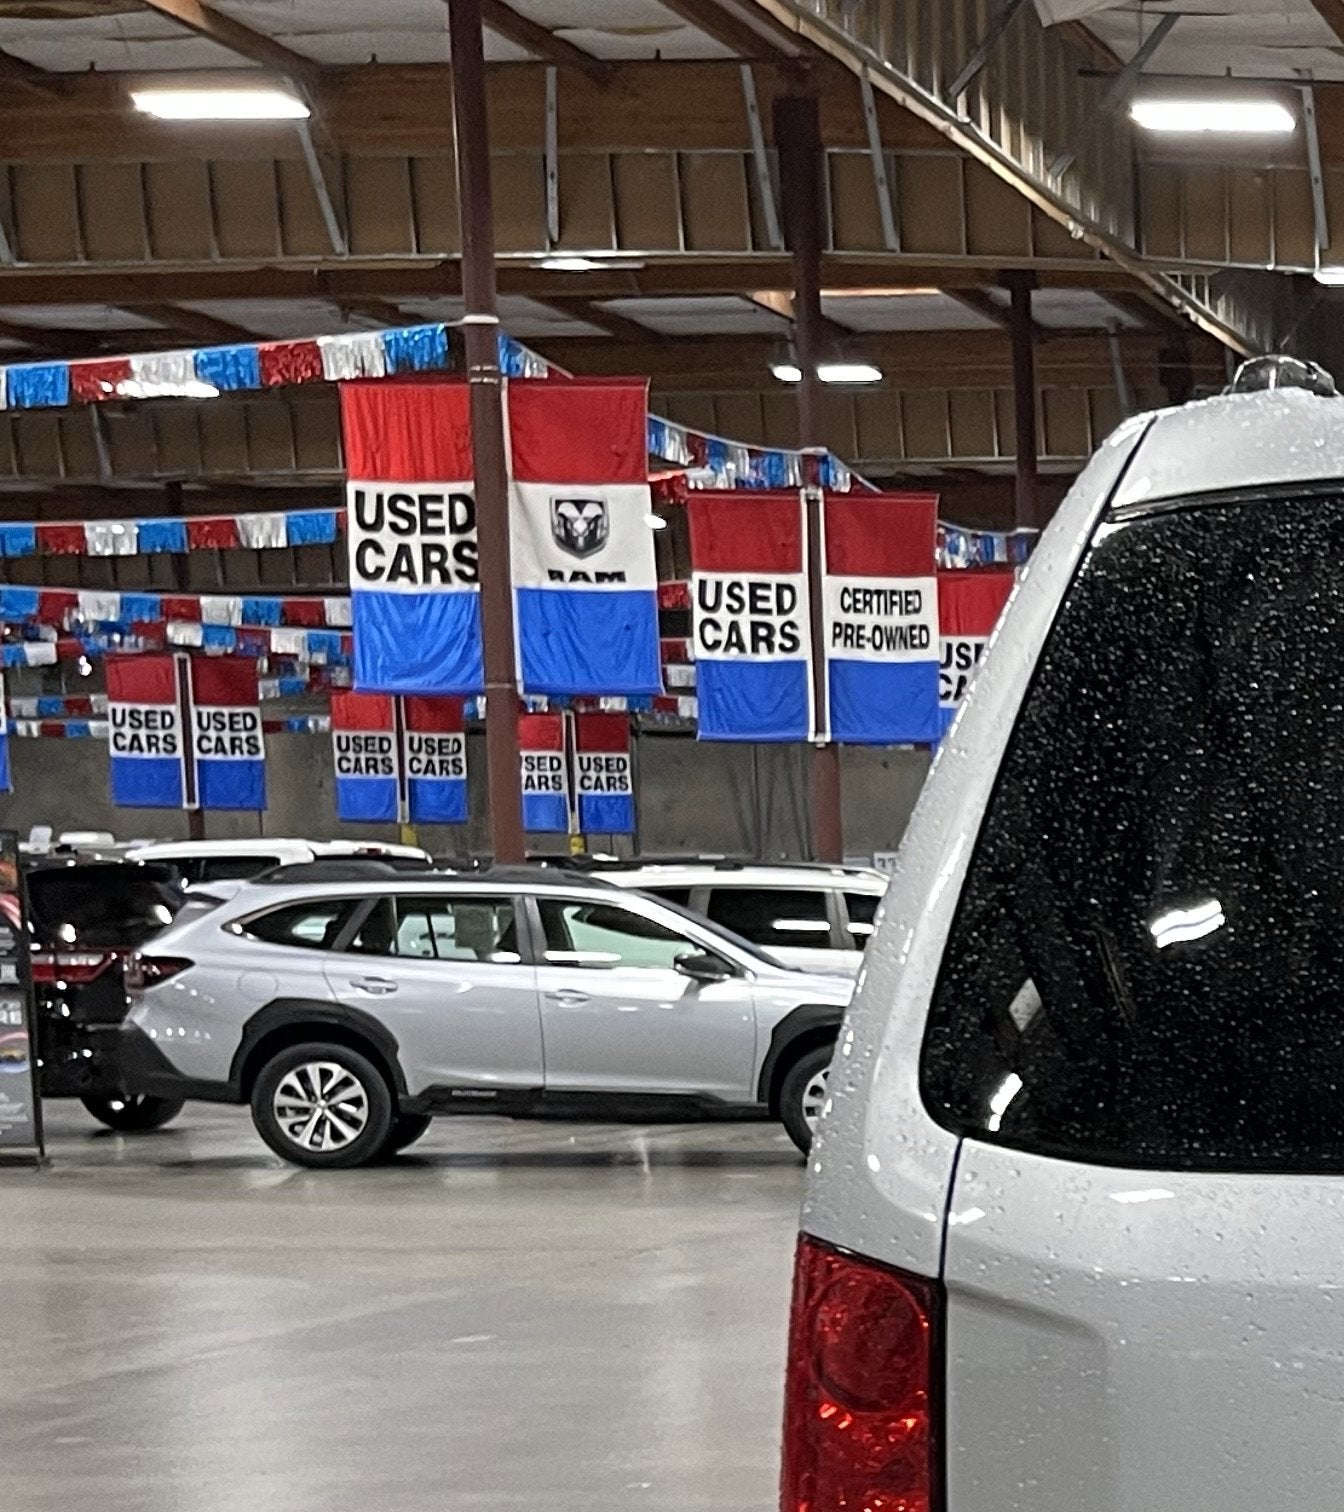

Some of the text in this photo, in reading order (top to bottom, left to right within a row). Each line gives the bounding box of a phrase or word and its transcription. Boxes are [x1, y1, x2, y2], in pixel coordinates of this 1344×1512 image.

[354, 489, 476, 536] USED
[354, 538, 480, 585] CARS
[698, 578, 798, 617] USED
[840, 587, 923, 616] CERTIFIED
[698, 617, 800, 655] CARS
[831, 621, 930, 651] PRE-OWNED
[111, 707, 175, 730] USED
[196, 710, 258, 733] USED
[112, 732, 178, 754] CARS
[196, 735, 261, 756] CARS
[336, 735, 392, 754] USED
[408, 736, 462, 756] USED
[337, 756, 394, 776] CARS
[408, 757, 464, 776] CARS
[523, 755, 562, 773] SED
[579, 756, 628, 774] USED
[523, 773, 562, 791] ARS
[579, 775, 629, 792] CARS
